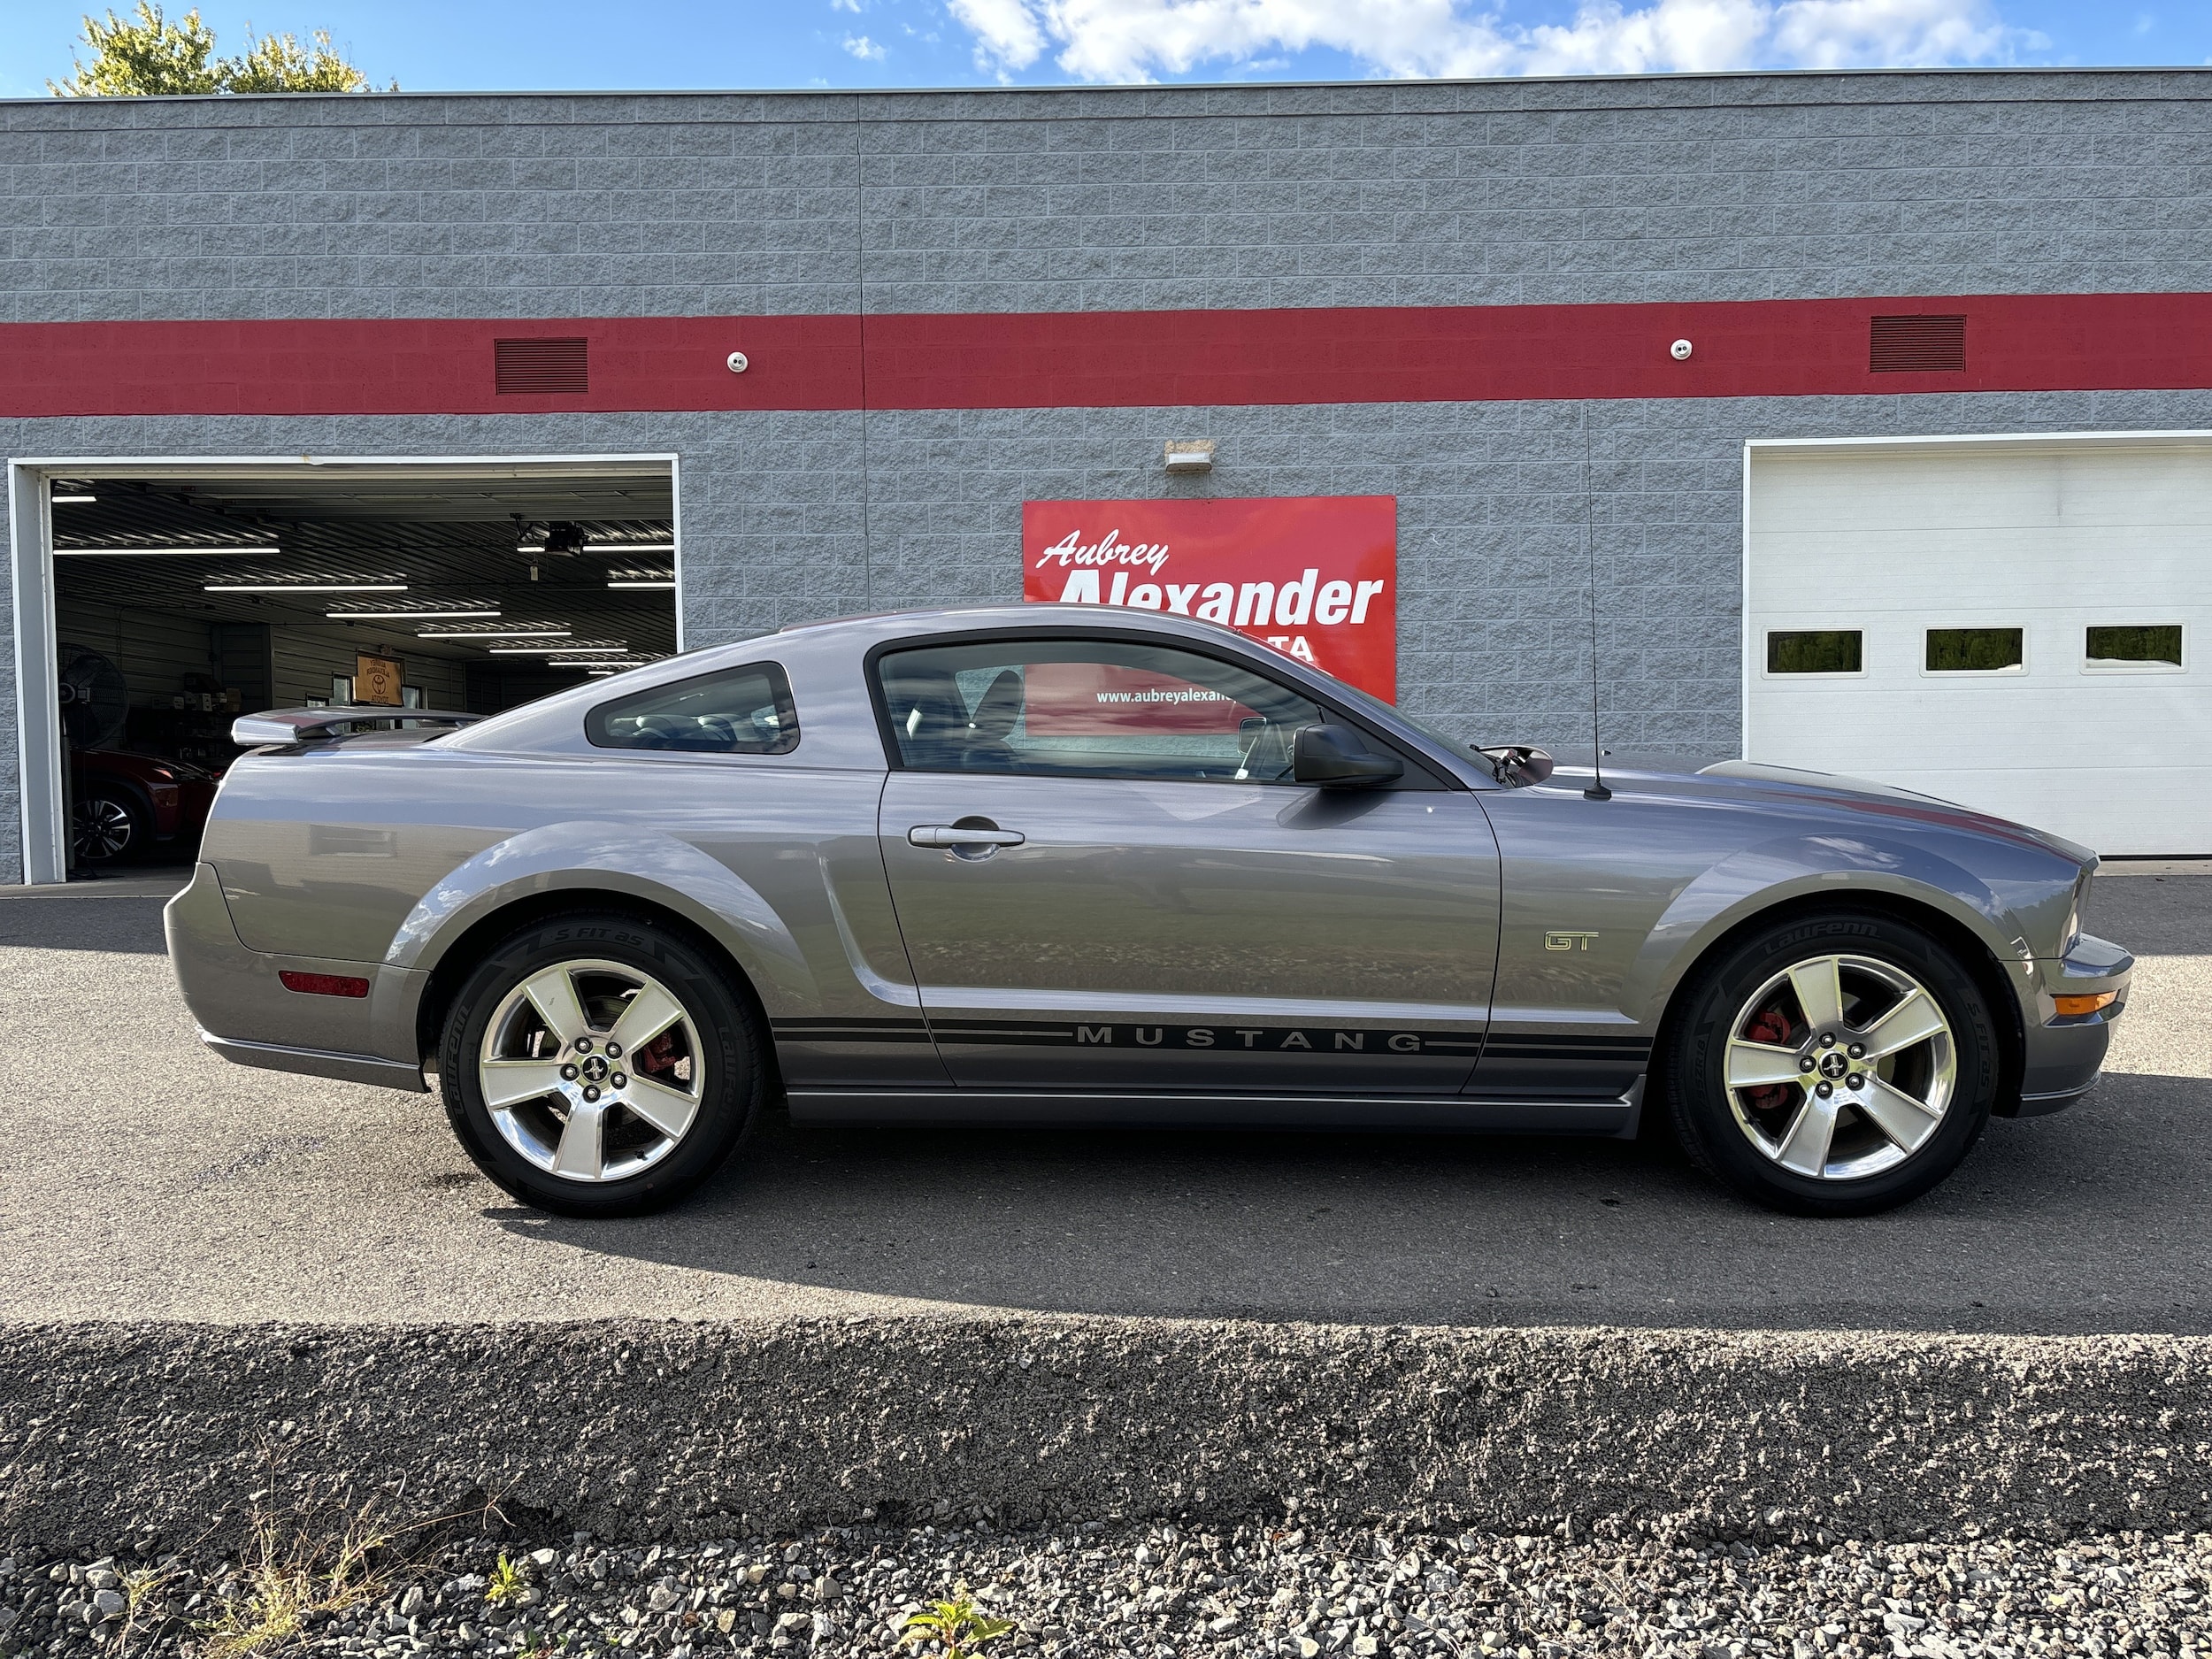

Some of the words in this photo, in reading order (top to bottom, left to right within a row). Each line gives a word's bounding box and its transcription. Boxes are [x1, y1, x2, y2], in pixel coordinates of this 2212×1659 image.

[1035, 529, 1170, 575] Aubrey
[1058, 568, 1384, 627] Alexander
[1097, 687, 1233, 705] www.aubreyalexan
[1544, 931, 1600, 951] GT
[1077, 1025, 1420, 1051] MUSTANG
